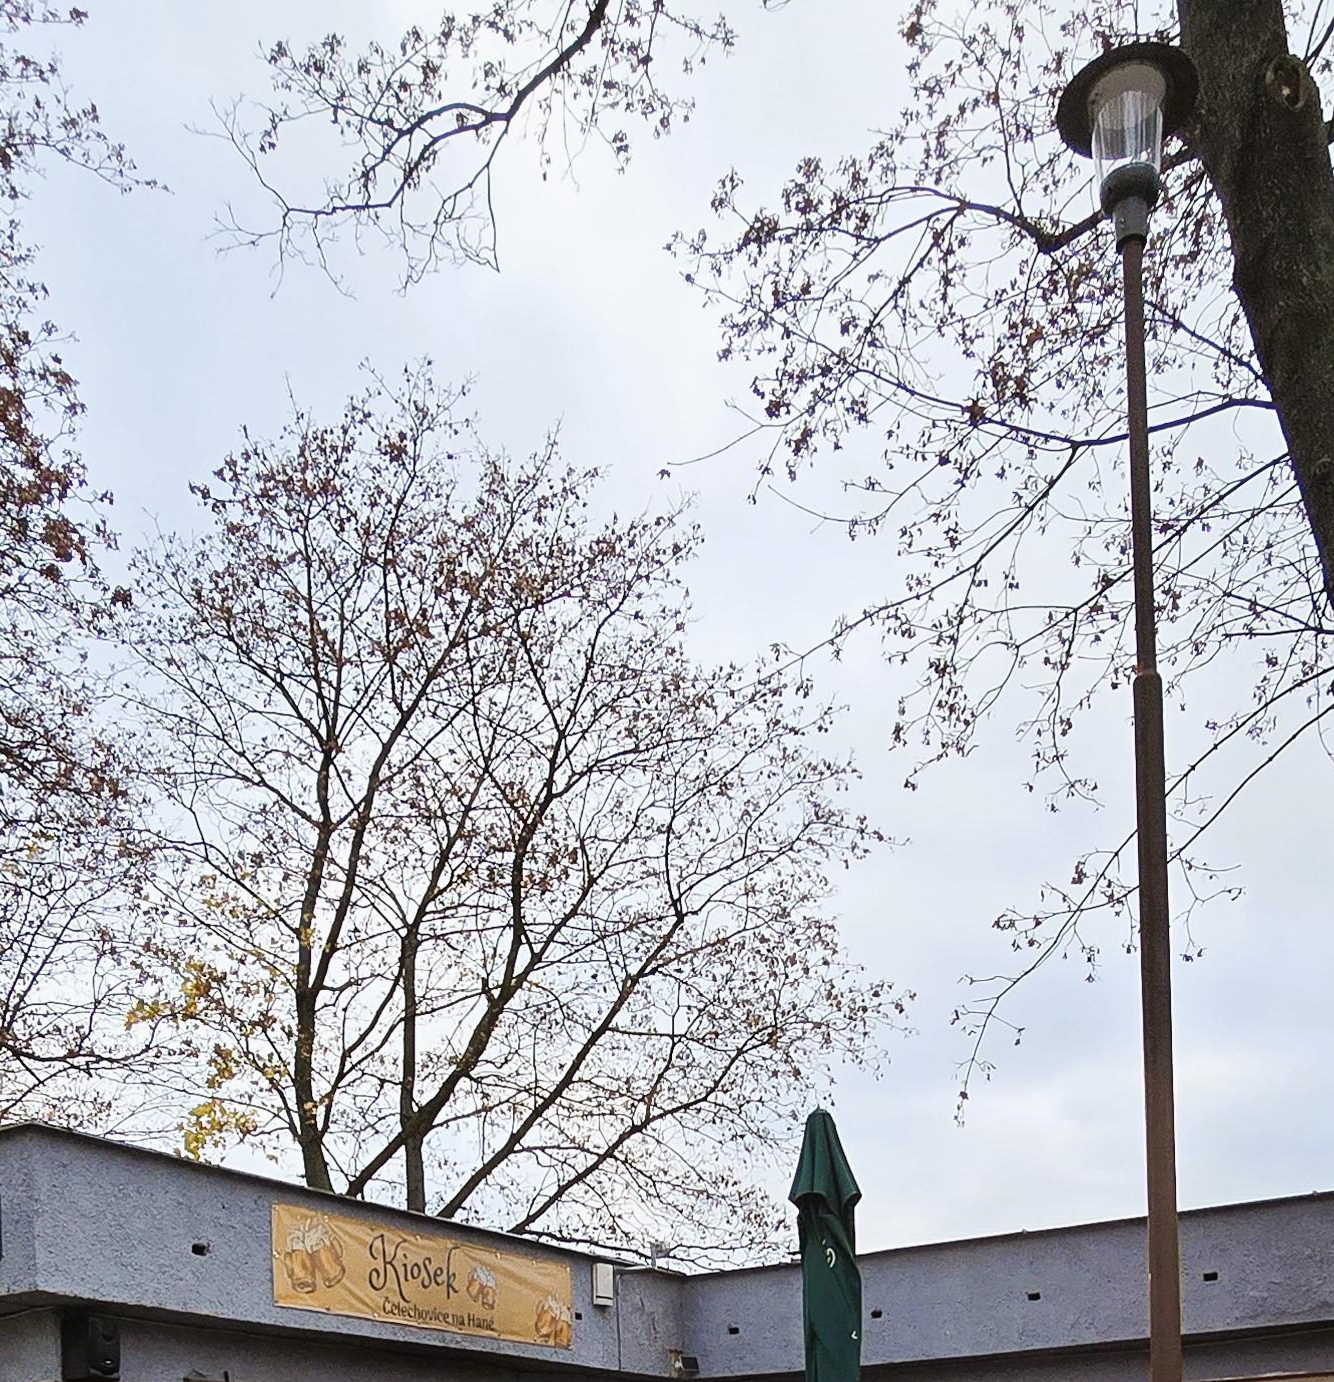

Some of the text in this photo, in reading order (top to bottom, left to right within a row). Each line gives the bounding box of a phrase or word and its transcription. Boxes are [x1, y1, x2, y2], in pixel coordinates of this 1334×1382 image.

[368, 1233, 460, 1303] Kiosek
[382, 1297, 495, 1331] Čelechovice na Hané
